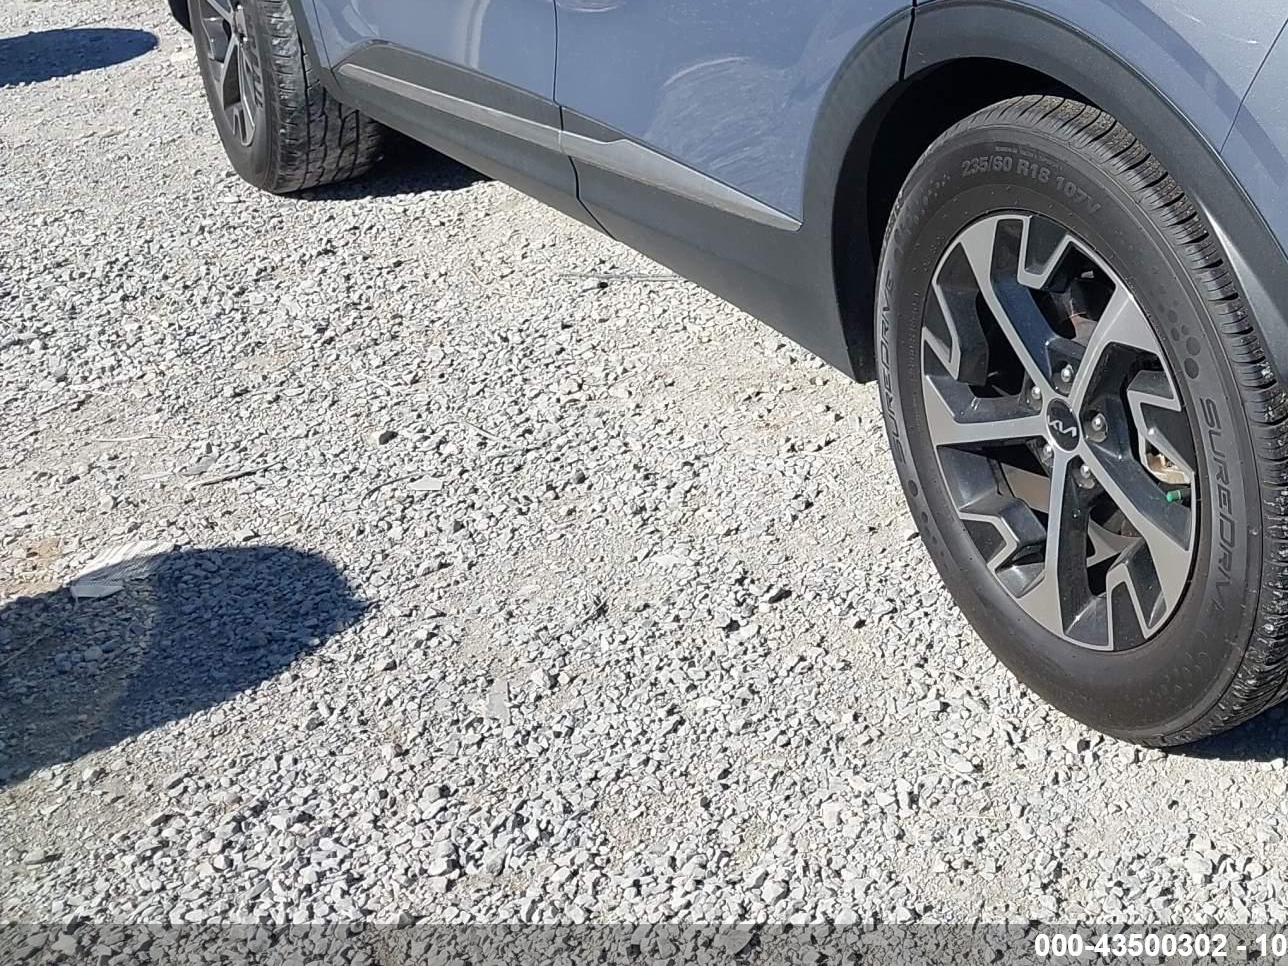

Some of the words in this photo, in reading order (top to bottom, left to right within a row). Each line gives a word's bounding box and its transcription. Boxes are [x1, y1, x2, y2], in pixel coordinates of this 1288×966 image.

[961, 155, 1013, 178] 235/60
[1016, 159, 1050, 183] R18
[879, 270, 907, 464] SUREDRIVE
